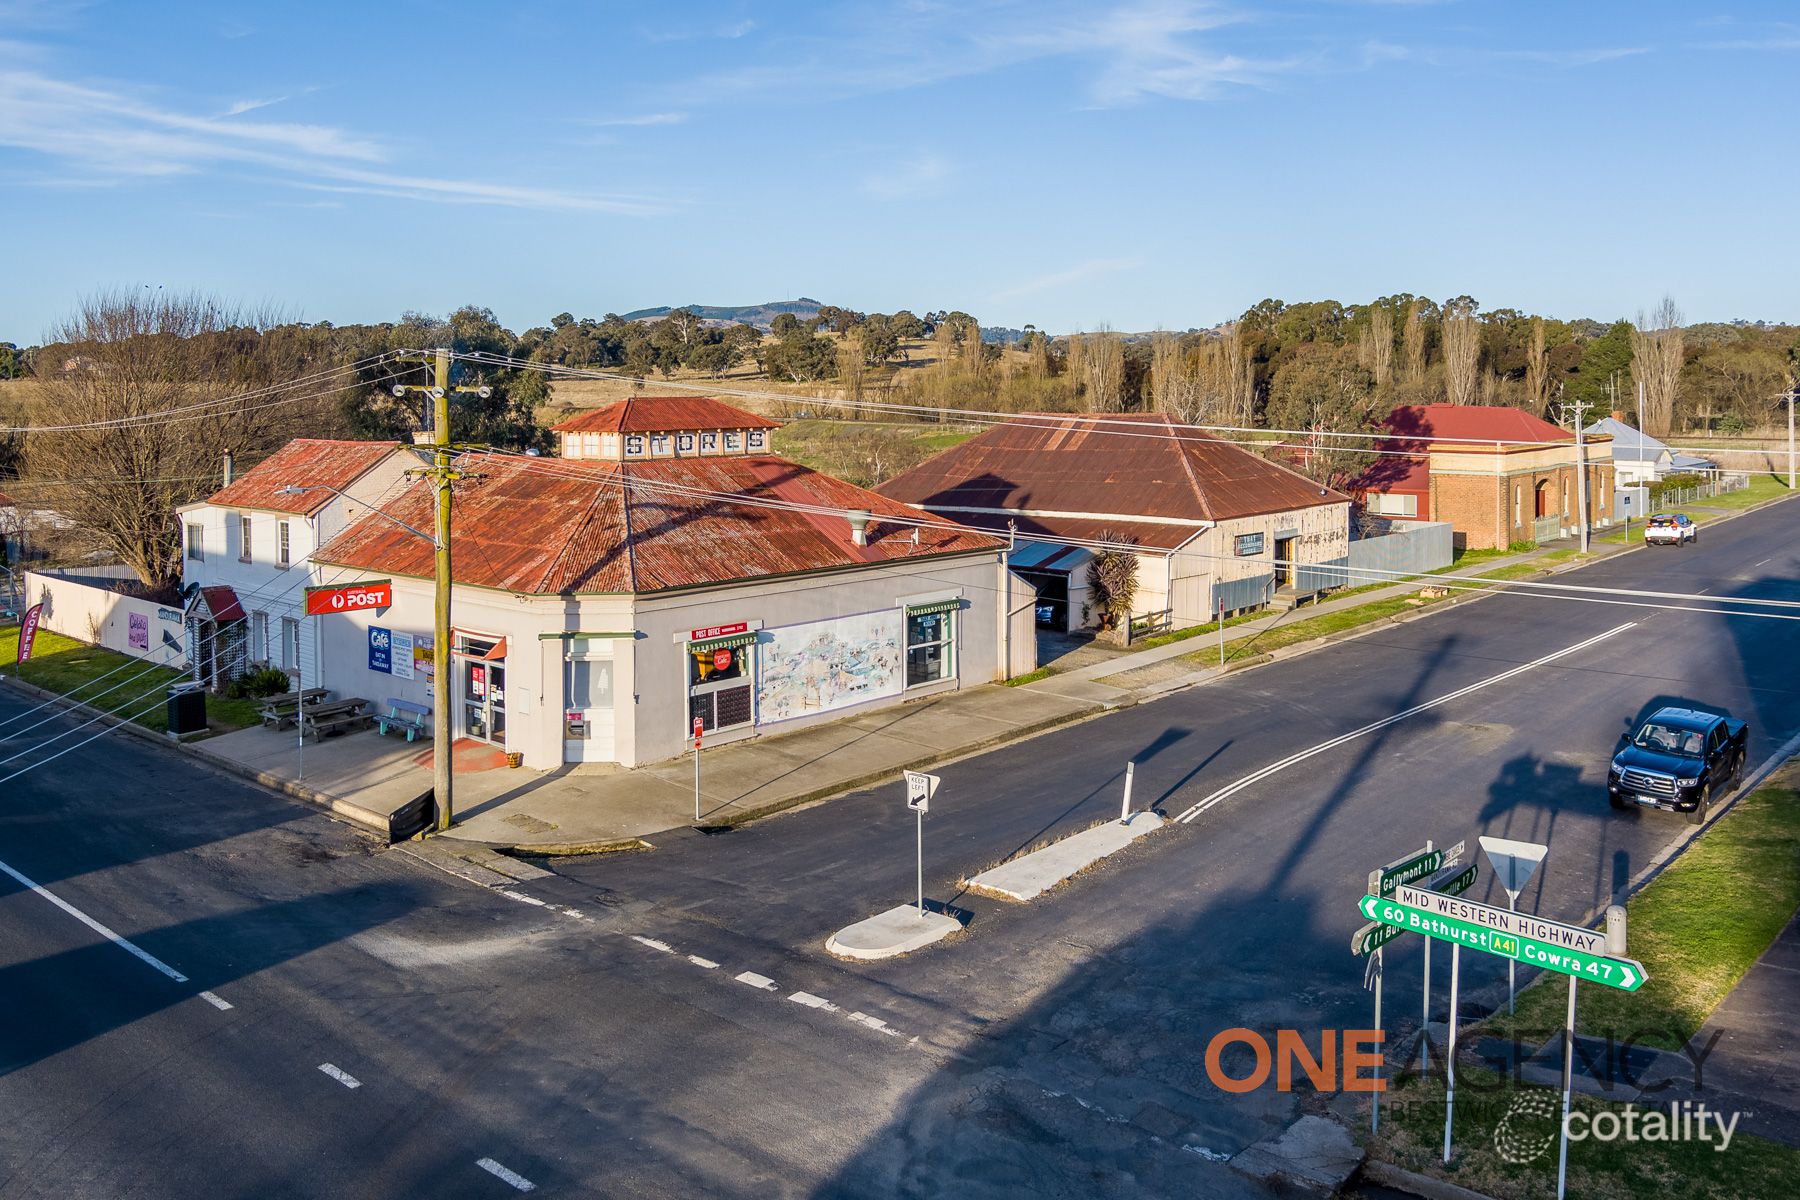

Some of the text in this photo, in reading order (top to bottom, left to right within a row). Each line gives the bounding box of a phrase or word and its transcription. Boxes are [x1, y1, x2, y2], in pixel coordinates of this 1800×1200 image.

[627, 432, 763, 454] STORES
[347, 592, 385, 607] POST
[22, 610, 38, 660] COFFEE
[371, 631, 389, 648] Café
[695, 629, 707, 639] POST
[707, 627, 721, 637] OFFICE
[1383, 857, 1432, 891] Gallymont 11
[1463, 872, 1470, 887] 17
[1403, 890, 1597, 951] MID WESTERN HIGHWAY
[1374, 932, 1383, 945] 11
[1383, 906, 1613, 979] 60 Bathurst A41 Cowra 47
